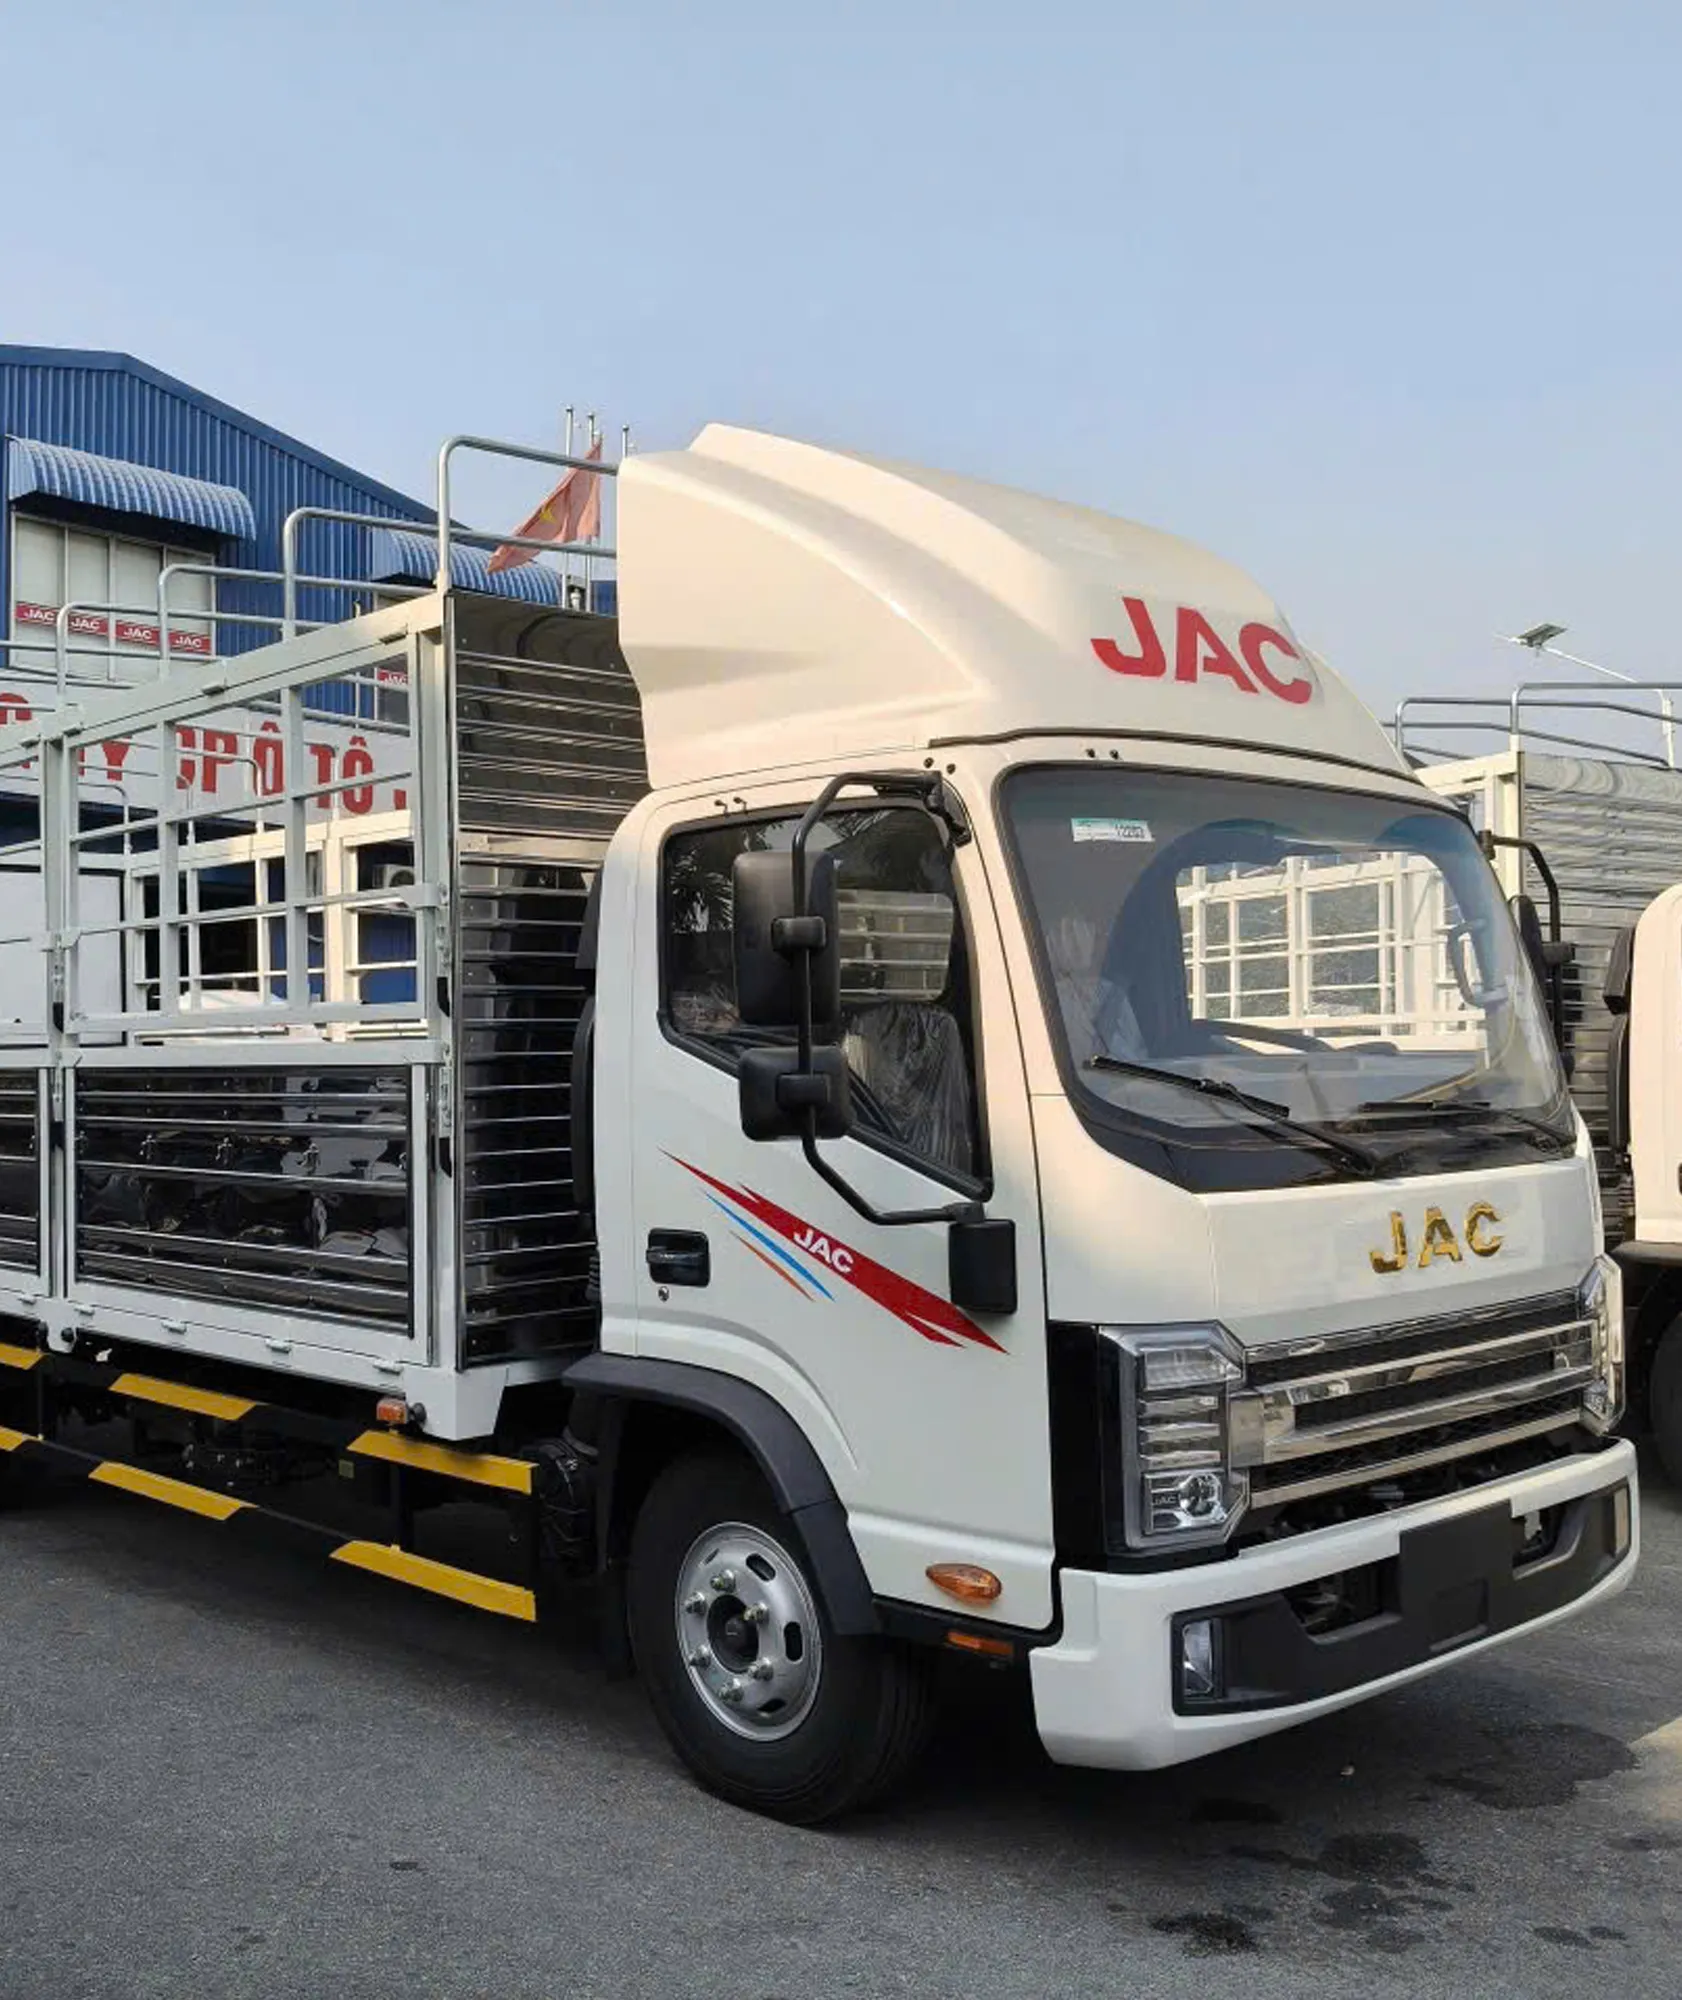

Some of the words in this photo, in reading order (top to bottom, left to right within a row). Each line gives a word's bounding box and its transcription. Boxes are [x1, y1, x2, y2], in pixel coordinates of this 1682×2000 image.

[23, 609, 55, 621] JAC
[71, 617, 101, 630] JAC
[123, 627, 153, 640] JAC
[175, 636, 202, 648] JAC
[1091, 596, 1312, 704] JAC
[310, 735, 374, 815] TÔ
[793, 1228, 854, 1273] JAC
[1369, 1201, 1504, 1274] JAC
